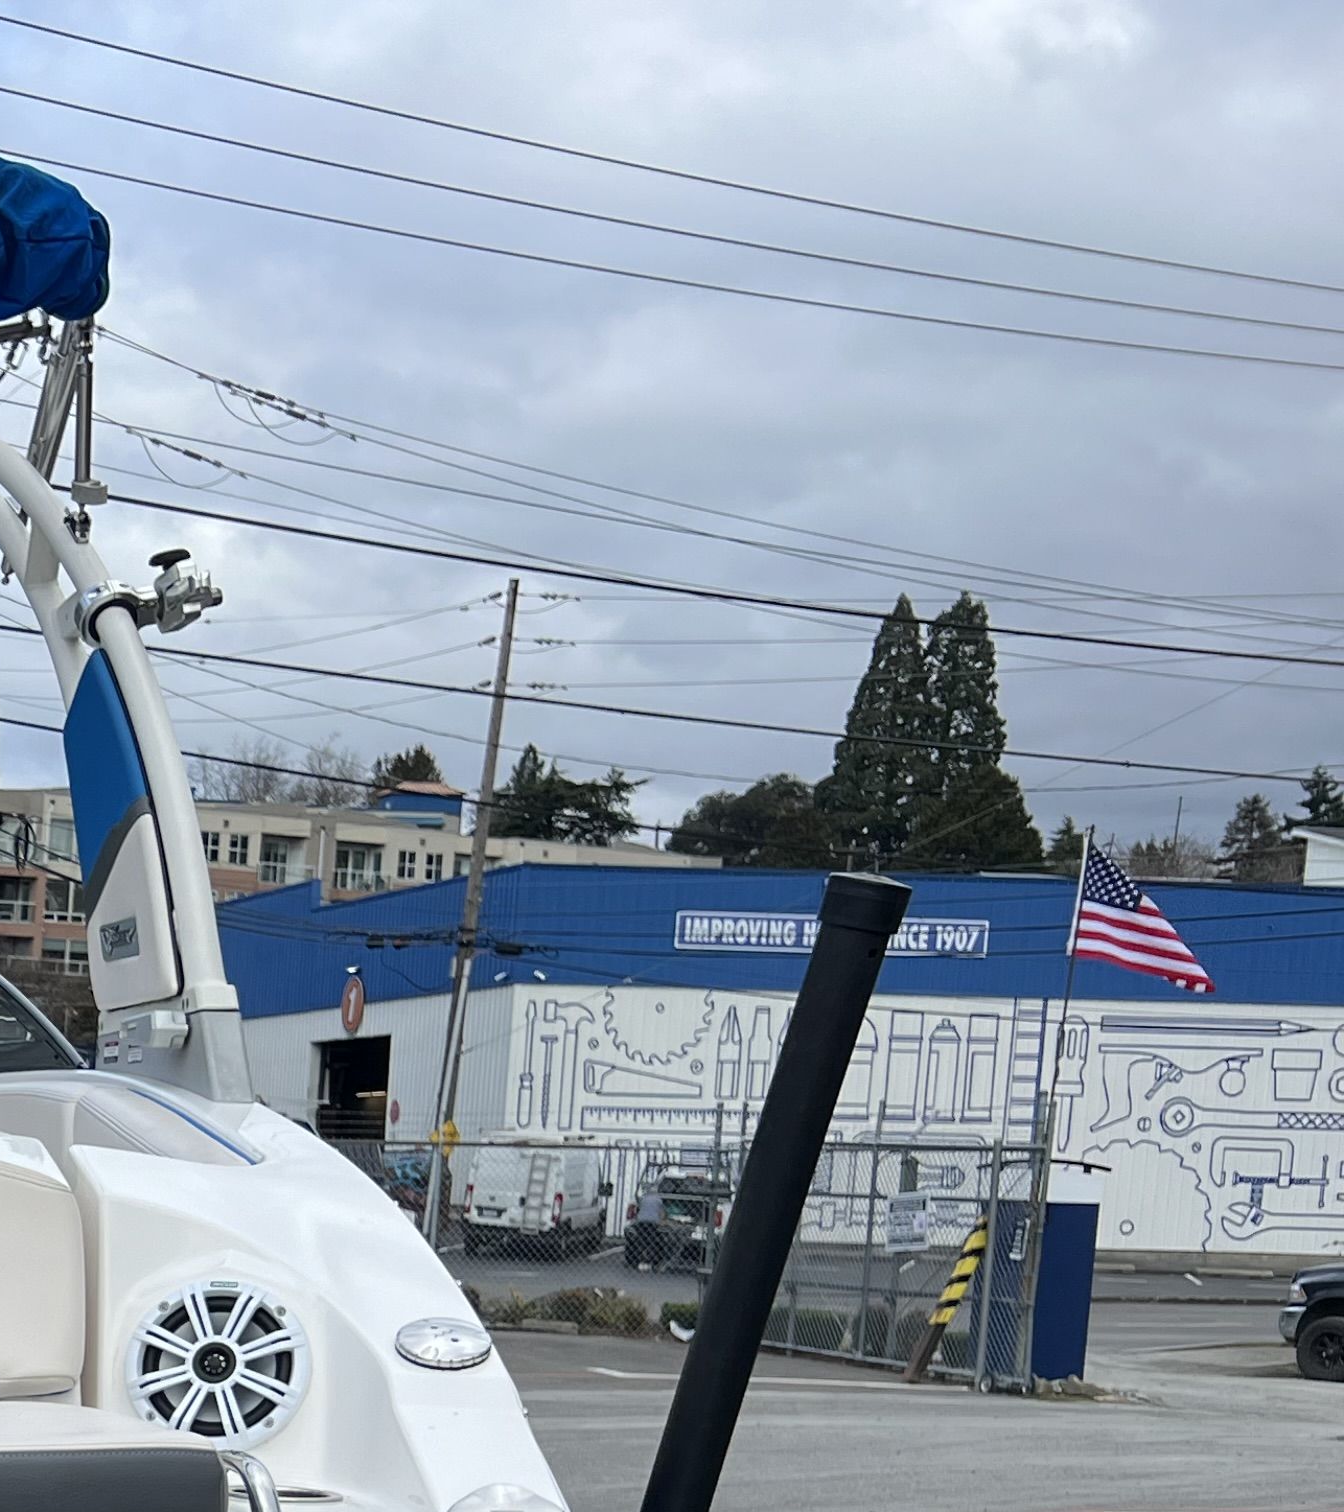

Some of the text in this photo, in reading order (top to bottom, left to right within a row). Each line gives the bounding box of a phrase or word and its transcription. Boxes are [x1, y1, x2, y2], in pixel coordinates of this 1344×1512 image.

[684, 917, 796, 946] IMPROVING
[935, 925, 980, 952] 1907
[348, 986, 357, 1023] 1
